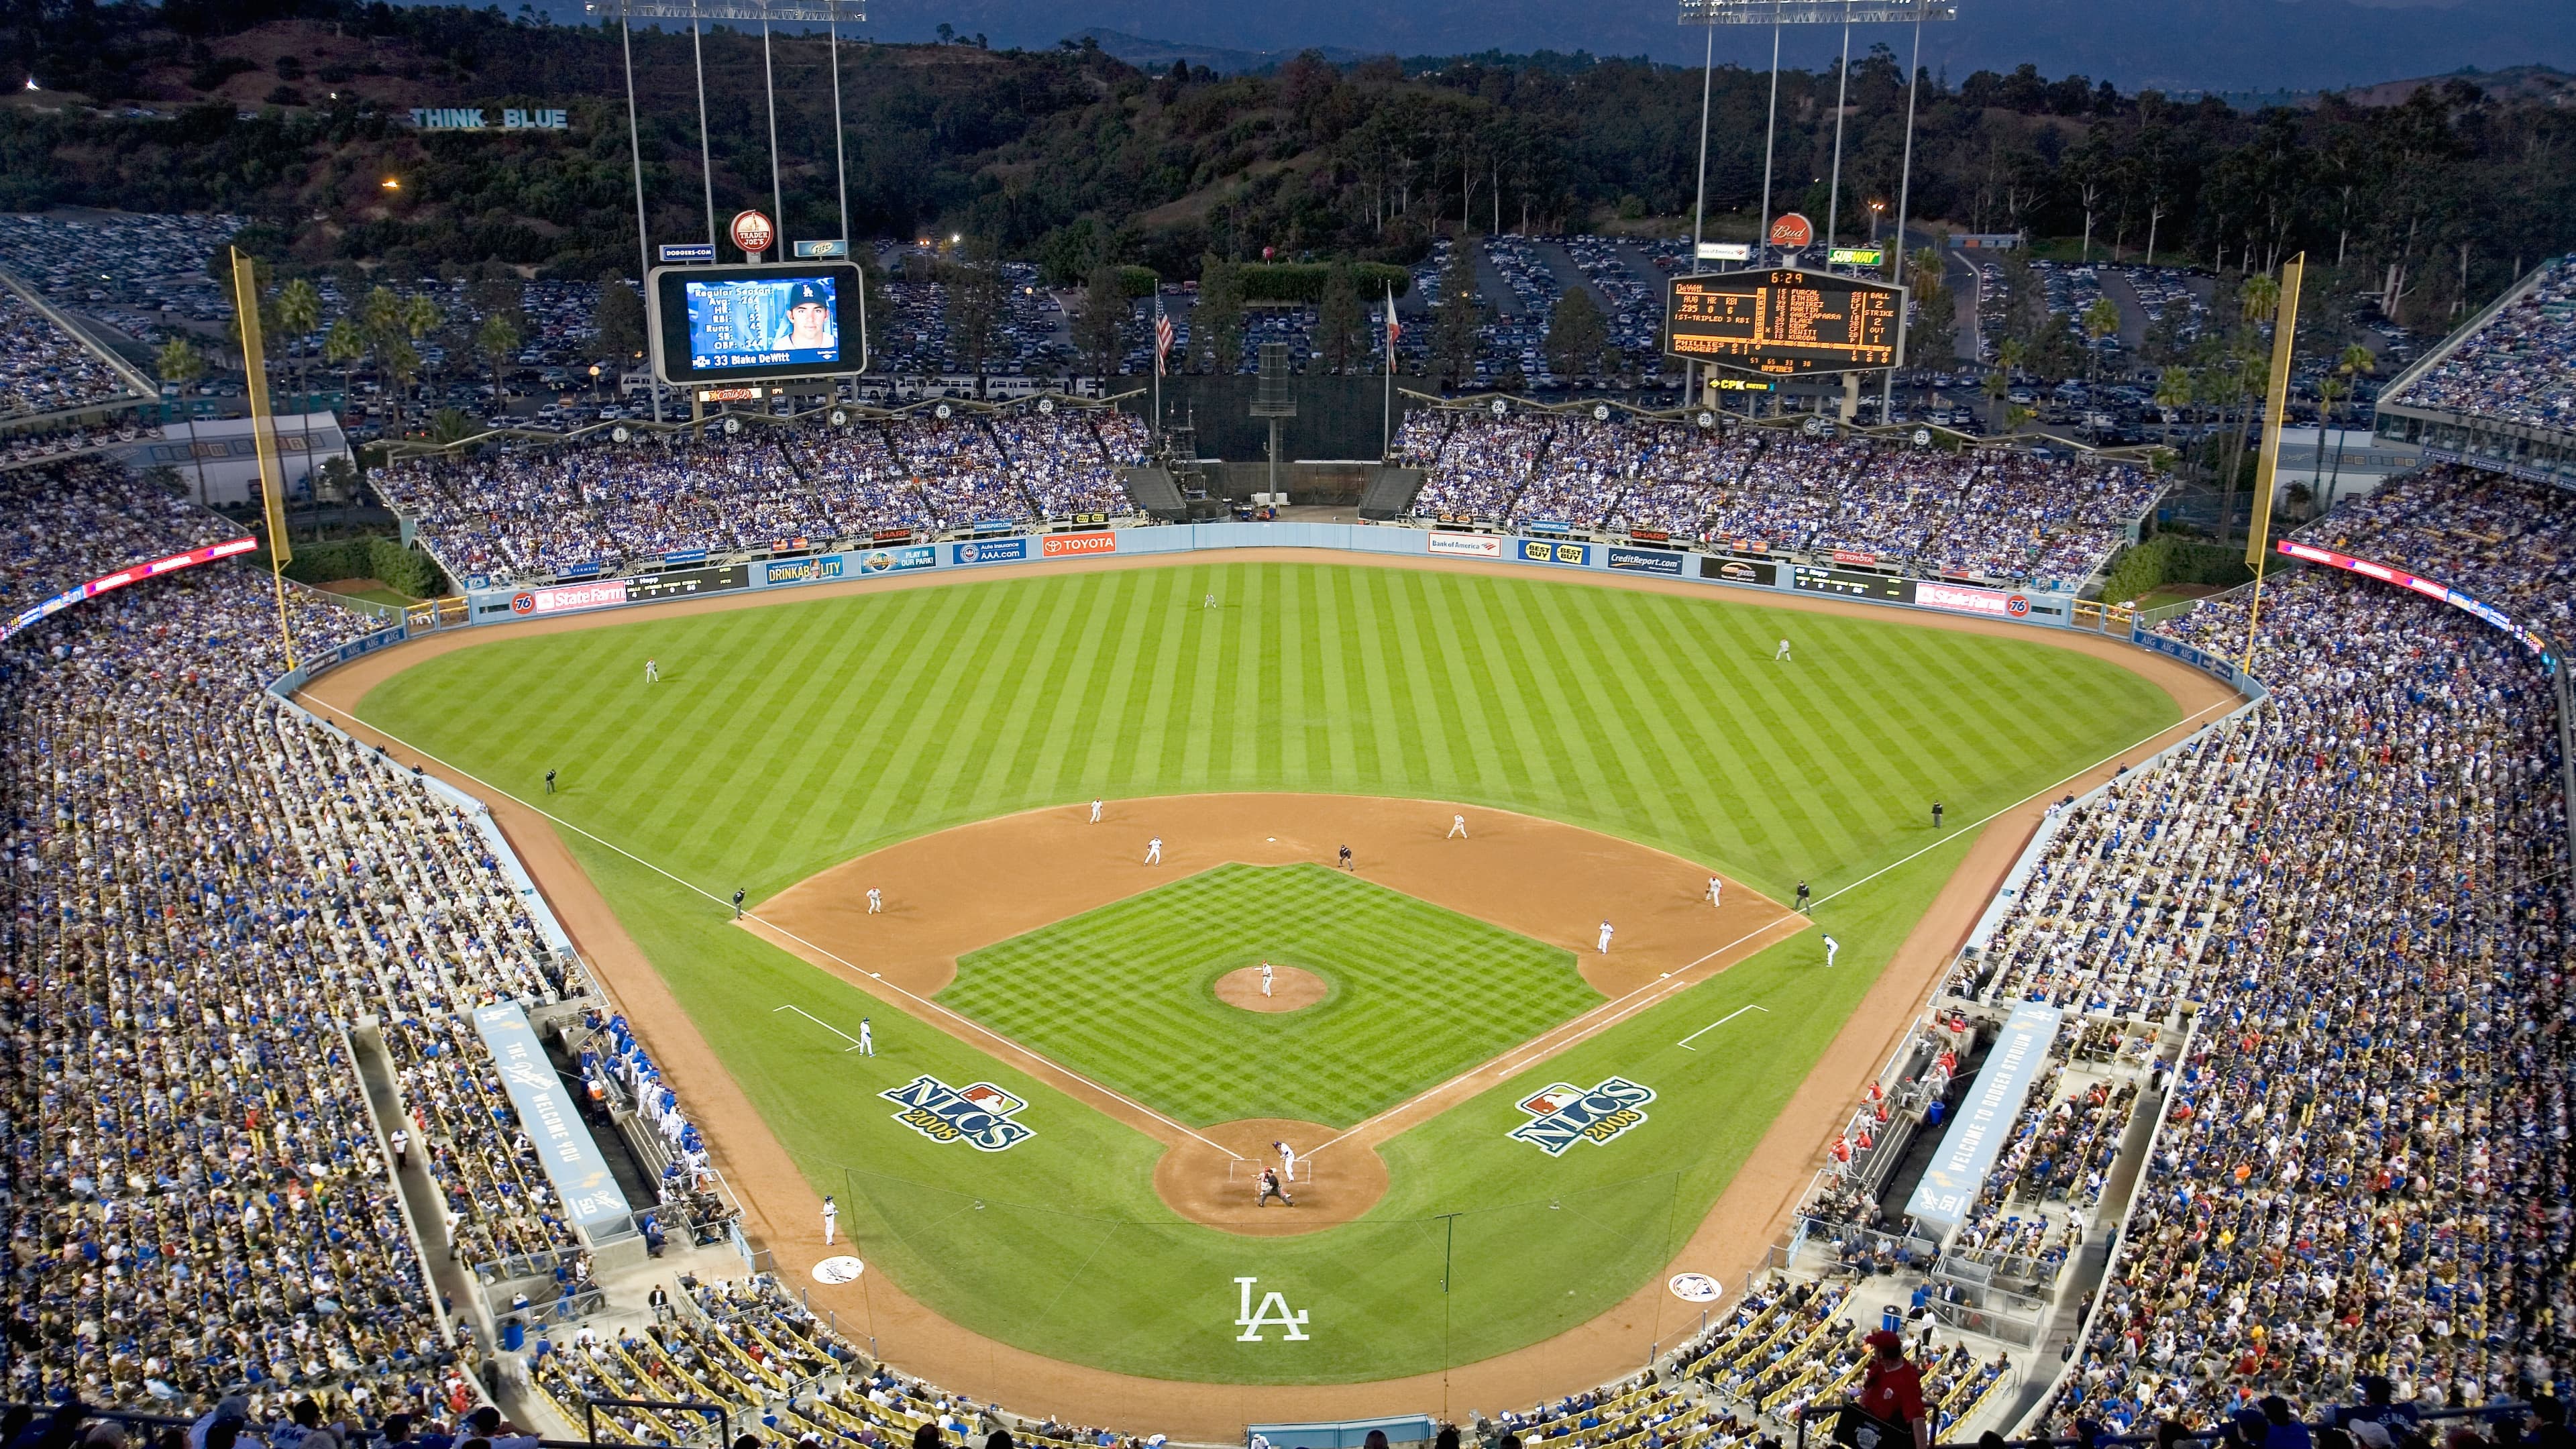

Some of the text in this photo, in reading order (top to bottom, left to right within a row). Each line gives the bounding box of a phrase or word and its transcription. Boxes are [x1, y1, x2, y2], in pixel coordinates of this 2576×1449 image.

[409, 108, 568, 128] THINK BLUE
[1772, 225, 1806, 239] Bud
[1829, 250, 1880, 264] SUBWAY
[1772, 272, 1803, 283] 6:29
[694, 288, 733, 299] Regular
[1707, 297, 1717, 305] HR
[1725, 297, 1738, 305] RBI
[1875, 301, 1884, 309] 2
[1707, 305, 1714, 313] 0
[1789, 312, 1841, 320] GARCIAPARRA
[1874, 318, 1882, 326] 2
[1874, 335, 1879, 343] 1
[714, 355, 729, 366] 33
[731, 354, 756, 365] Blake
[759, 352, 790, 364] DeWitt
[1721, 379, 1745, 390] CPK
[718, 390, 739, 399] Carl's
[873, 530, 910, 539] SHARP
[1631, 531, 1668, 539] SHARP
[1063, 537, 1114, 550] TOYOTA
[1455, 541, 1480, 549] America
[1529, 545, 1550, 553] BEST
[981, 550, 1020, 559] AAA.com
[1560, 547, 1581, 555] BEST
[1611, 553, 1678, 568] CreditReport.com
[1845, 554, 1873, 563] TOYOTA
[769, 562, 840, 582] DRINKABLITY
[515, 596, 532, 610] 76
[555, 587, 625, 607] State Farm
[1935, 589, 2006, 611] State Farm
[2010, 600, 2026, 612] 76
[347, 631, 399, 656] AIG AIG AIG
[2141, 636, 2193, 659] AIG AIG AIG
[2003, 1033, 2033, 1072] STADIUM
[1982, 1073, 2013, 1108] DODGER
[506, 1041, 527, 1060] THE
[532, 1092, 569, 1139] WELCOME
[556, 1140, 582, 1163] YOU
[885, 1077, 1029, 1148] NLCS
[1512, 1079, 1651, 1153] NLCS
[1974, 1109, 1994, 1123] TO
[903, 1110, 959, 1140] 2008
[1585, 1110, 1640, 1140] 2008
[1948, 1123, 1986, 1172] WELCOME
[578, 1197, 597, 1214] 50
[1938, 1195, 1957, 1212] 50
[1234, 1277, 1309, 1341] LA
